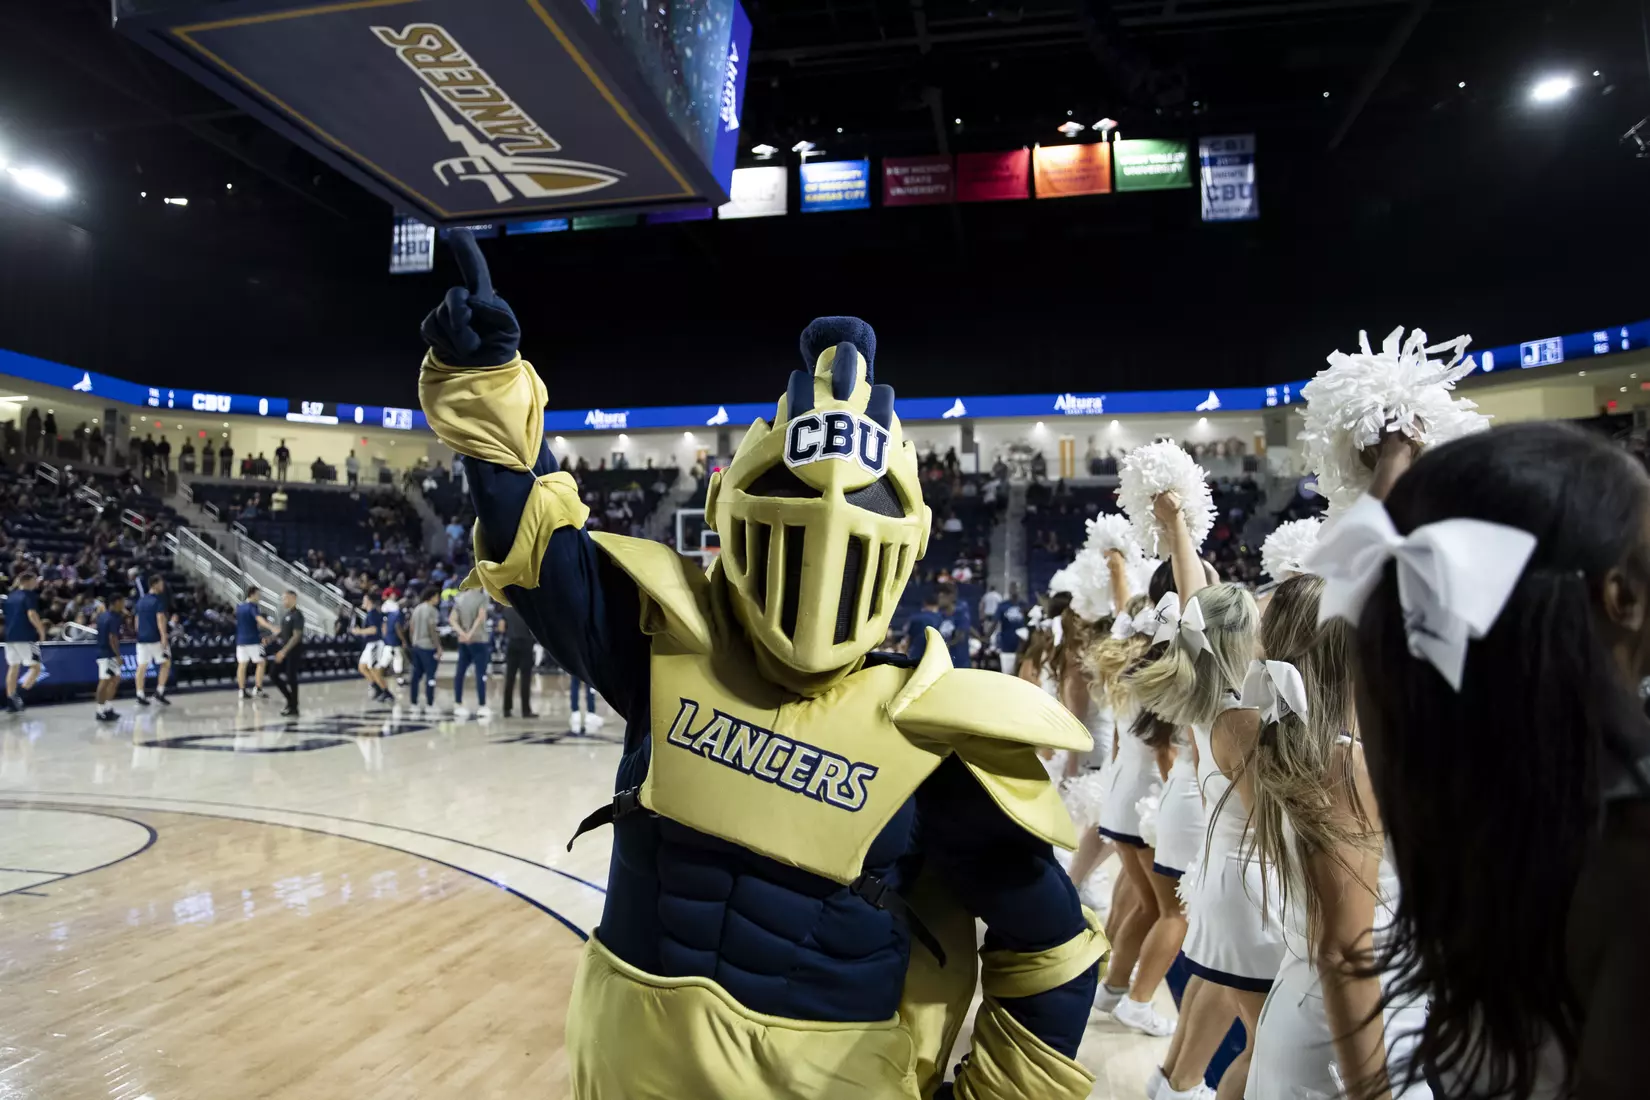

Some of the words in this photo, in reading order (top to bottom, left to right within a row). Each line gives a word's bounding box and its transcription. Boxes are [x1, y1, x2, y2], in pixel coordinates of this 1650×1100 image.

[369, 23, 562, 155] LANCERS
[192, 393, 231, 412] CBU
[1054, 394, 1103, 410] Altura
[785, 411, 891, 477] CBU
[667, 698, 879, 812] LANCERS
